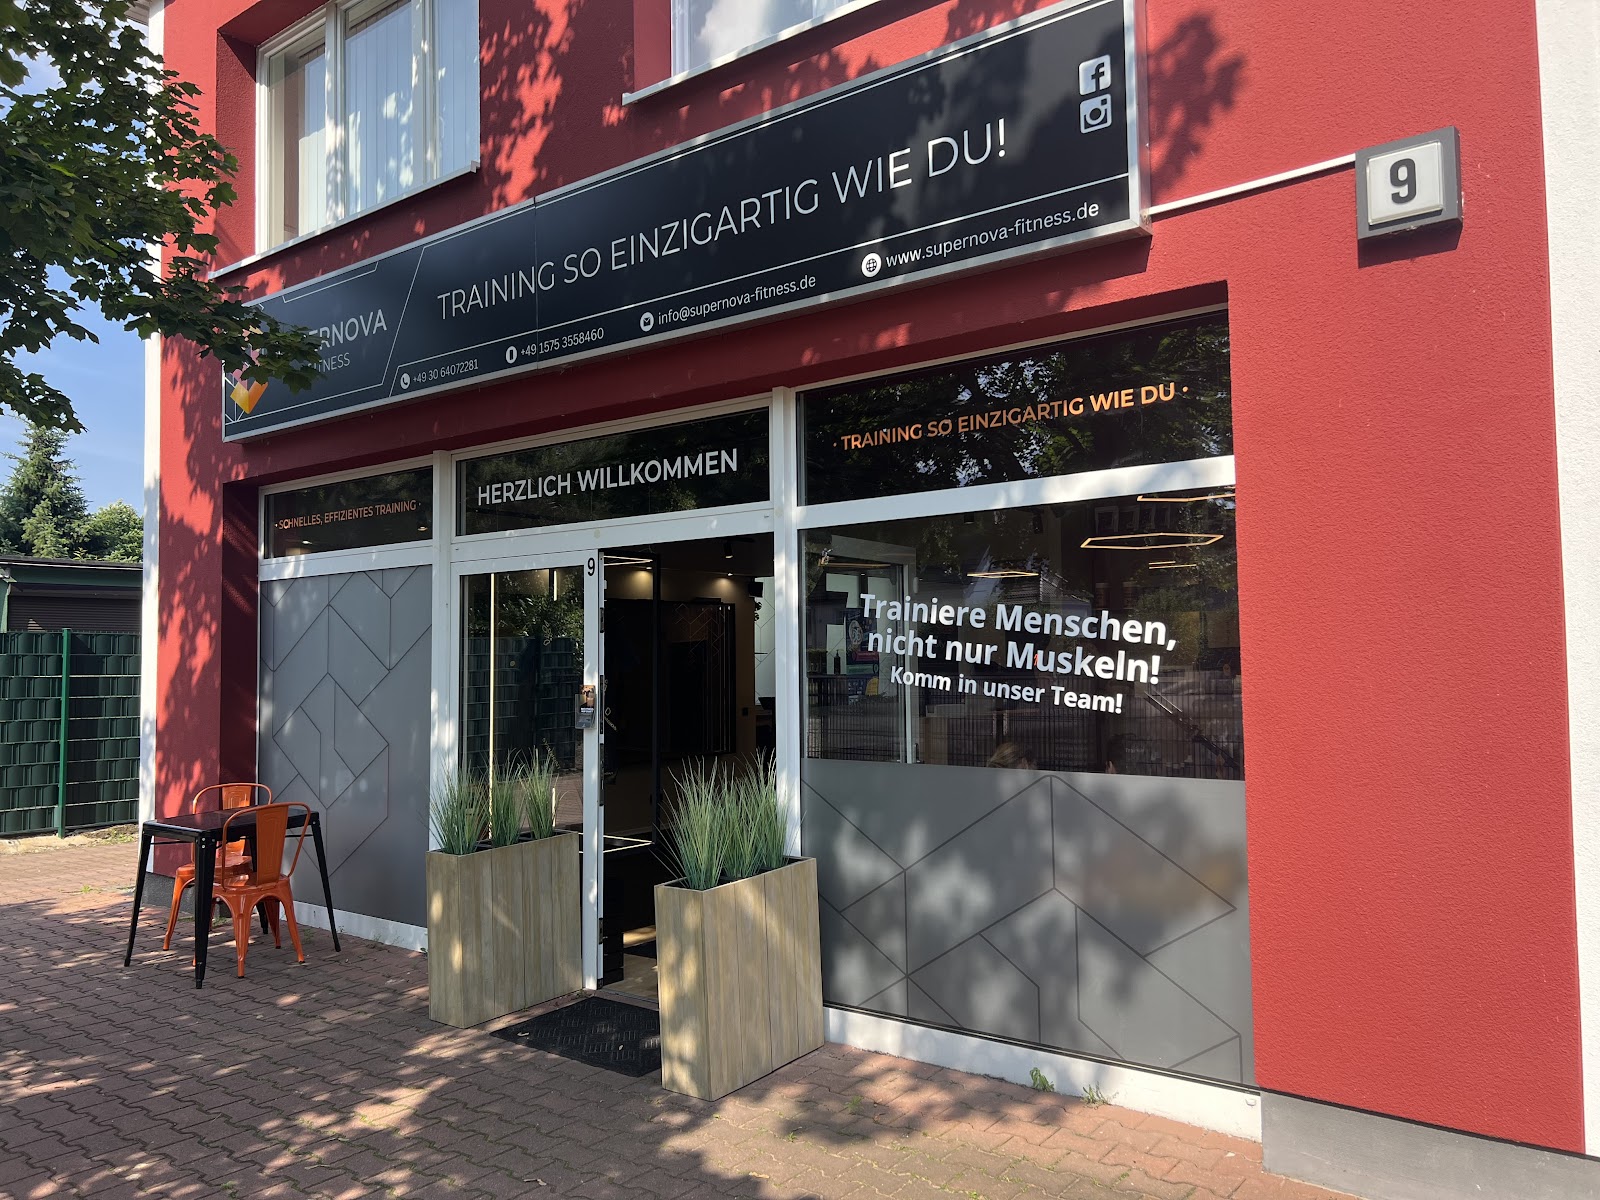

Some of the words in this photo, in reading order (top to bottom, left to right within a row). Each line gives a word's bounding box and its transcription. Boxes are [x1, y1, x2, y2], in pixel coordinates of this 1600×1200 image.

[1390, 158, 1417, 205] 9
[437, 261, 555, 320] TRAINING
[563, 247, 601, 284] SO
[611, 178, 820, 270] EINZIGARTIG
[832, 147, 913, 204] WIE
[927, 117, 1007, 178] DU!
[885, 202, 1100, 268] www.supernova-fitness.de
[658, 273, 817, 326] info@supernova-fitness.de
[520, 342, 537, 357] +49
[539, 335, 561, 353] 1575
[561, 327, 605, 350] 3558460
[413, 371, 427, 383] +49
[428, 369, 439, 381] 30
[440, 358, 479, 378] 64072281
[841, 424, 923, 452] TRAINING
[927, 418, 953, 437] SO
[958, 397, 1085, 433] EINZIGARTIG
[1089, 388, 1135, 412] WIE
[1140, 381, 1176, 406] DU
[478, 475, 571, 507] HERZLICH
[576, 448, 739, 492] WILLKOMMEN
[279, 513, 323, 530] SCHNELLES,
[324, 505, 374, 524] EFFIZIENTES
[375, 499, 417, 516] TRAINING
[587, 557, 596, 577] 9
[860, 593, 987, 630] Trainiere
[995, 604, 1178, 651] Menschen,
[868, 627, 937, 660] nicht
[946, 639, 998, 666] nur
[1006, 641, 1161, 685] Muskeln!
[890, 665, 951, 692] Komm
[958, 672, 978, 695] in
[983, 681, 1045, 704] unser
[1050, 685, 1123, 715] Team!
